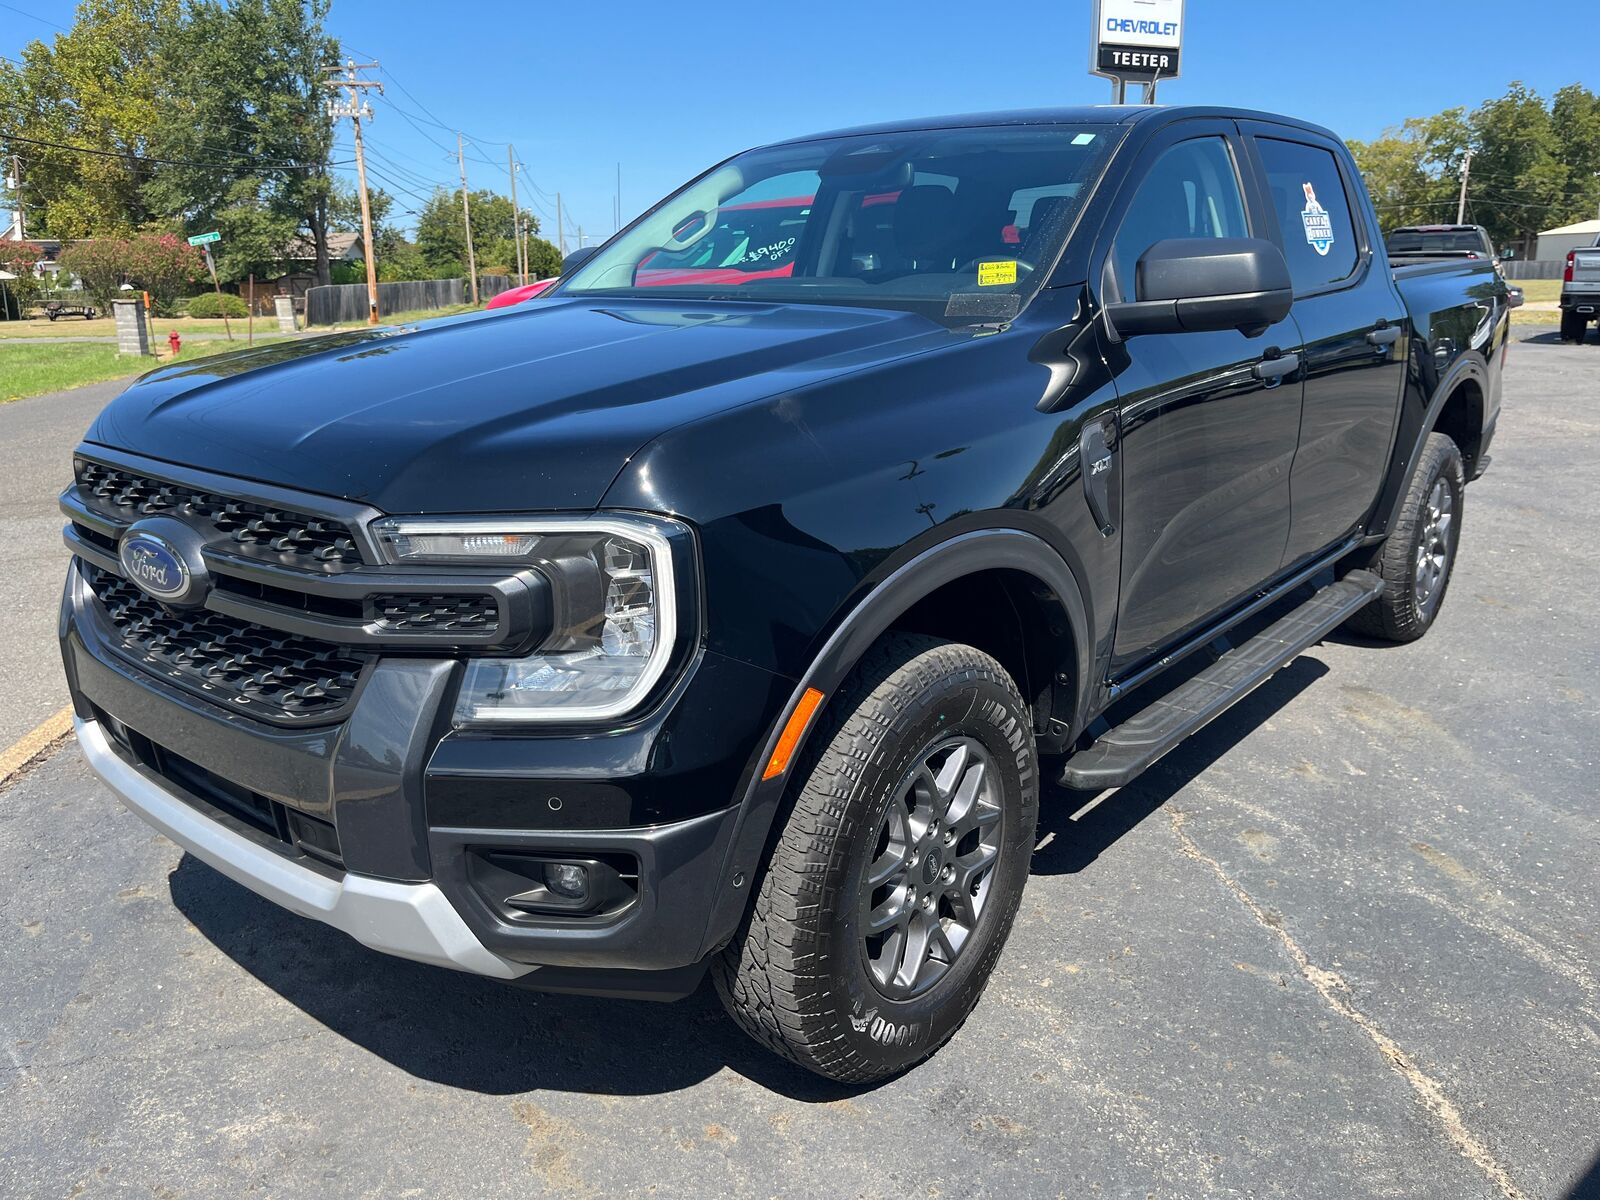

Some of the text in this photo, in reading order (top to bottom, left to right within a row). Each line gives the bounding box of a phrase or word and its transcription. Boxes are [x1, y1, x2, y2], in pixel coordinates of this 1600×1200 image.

[1107, 18, 1177, 36] CHEVROLET
[1113, 52, 1169, 68] TEETER
[749, 237, 796, 262] $9400
[770, 247, 792, 261] OFF
[1091, 455, 1111, 475] XLT
[131, 545, 168, 586] Ford
